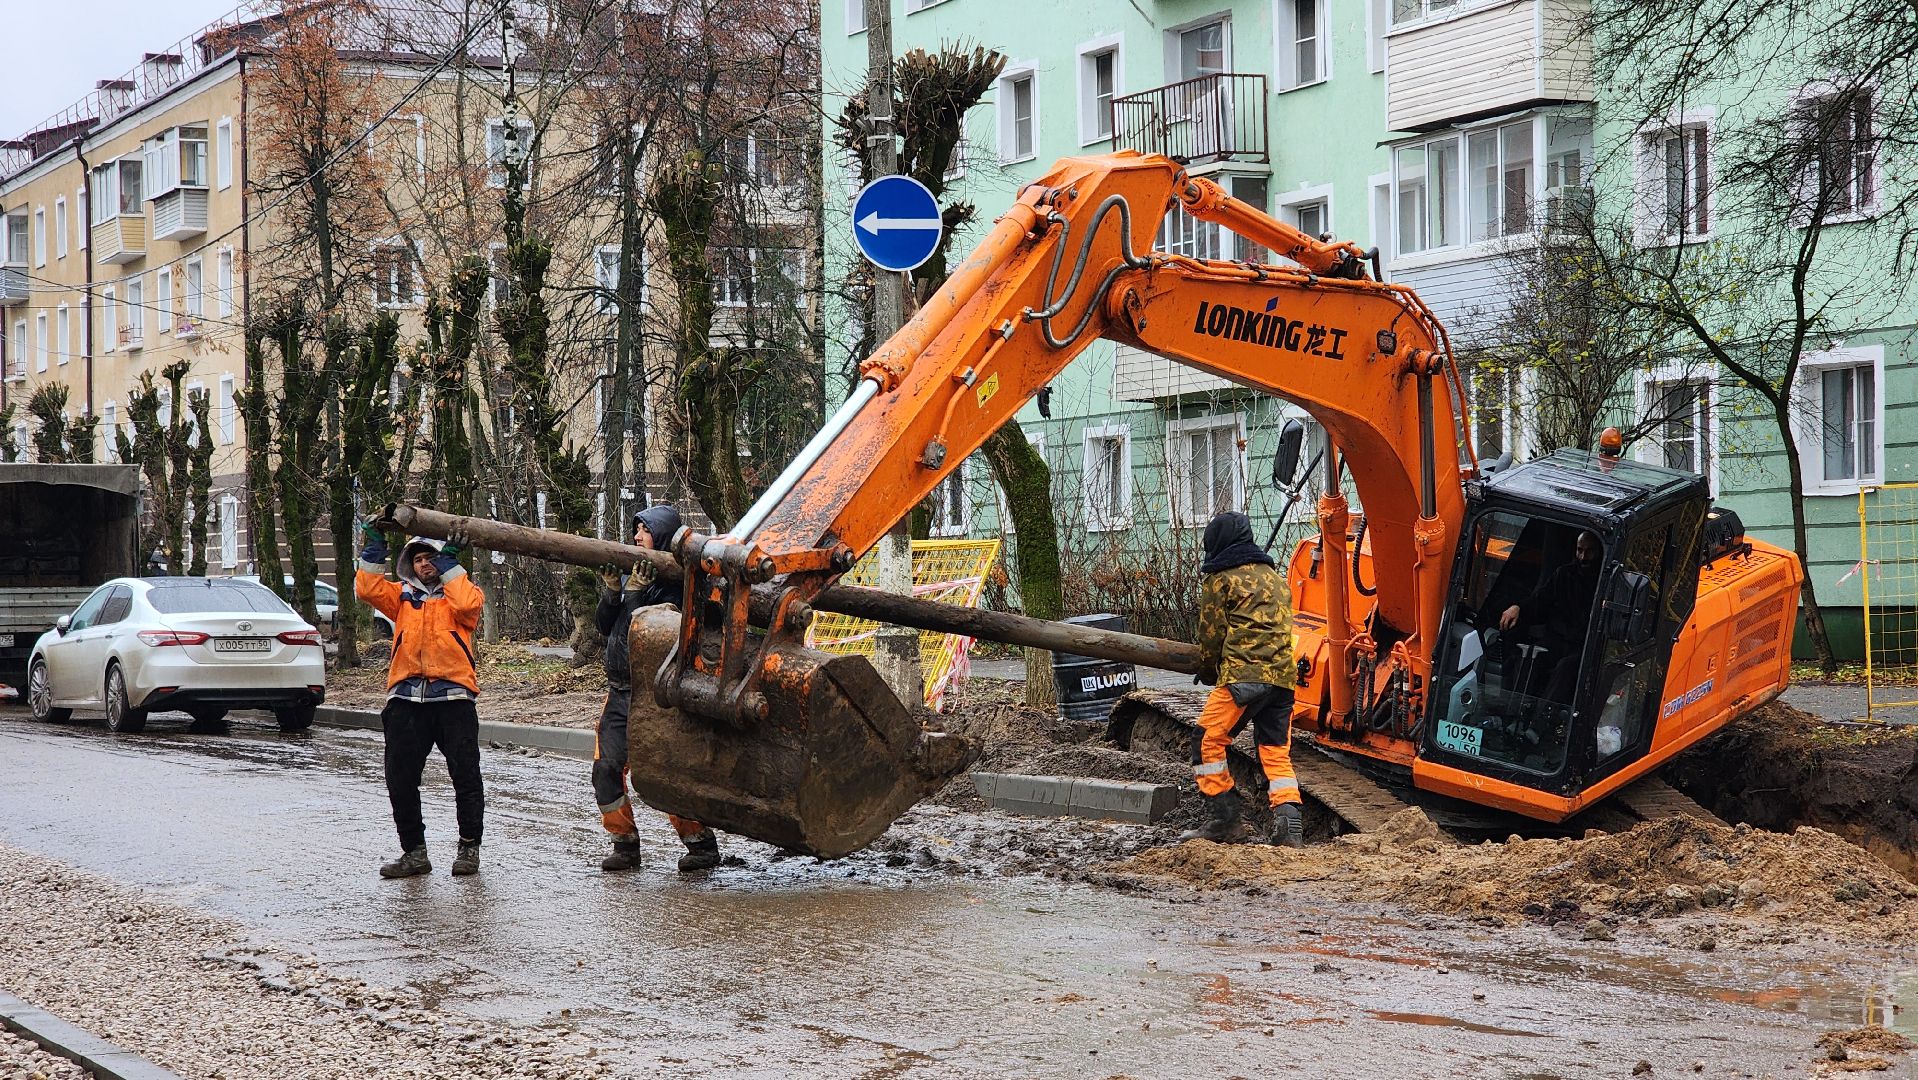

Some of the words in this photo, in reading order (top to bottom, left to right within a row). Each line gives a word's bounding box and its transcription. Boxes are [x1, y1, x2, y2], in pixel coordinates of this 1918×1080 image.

[1194, 298, 1304, 352] LONKING
[1096, 671, 1136, 689] LUKOIL
[1445, 724, 1476, 742] 1096
[1463, 744, 1477, 755] 50
